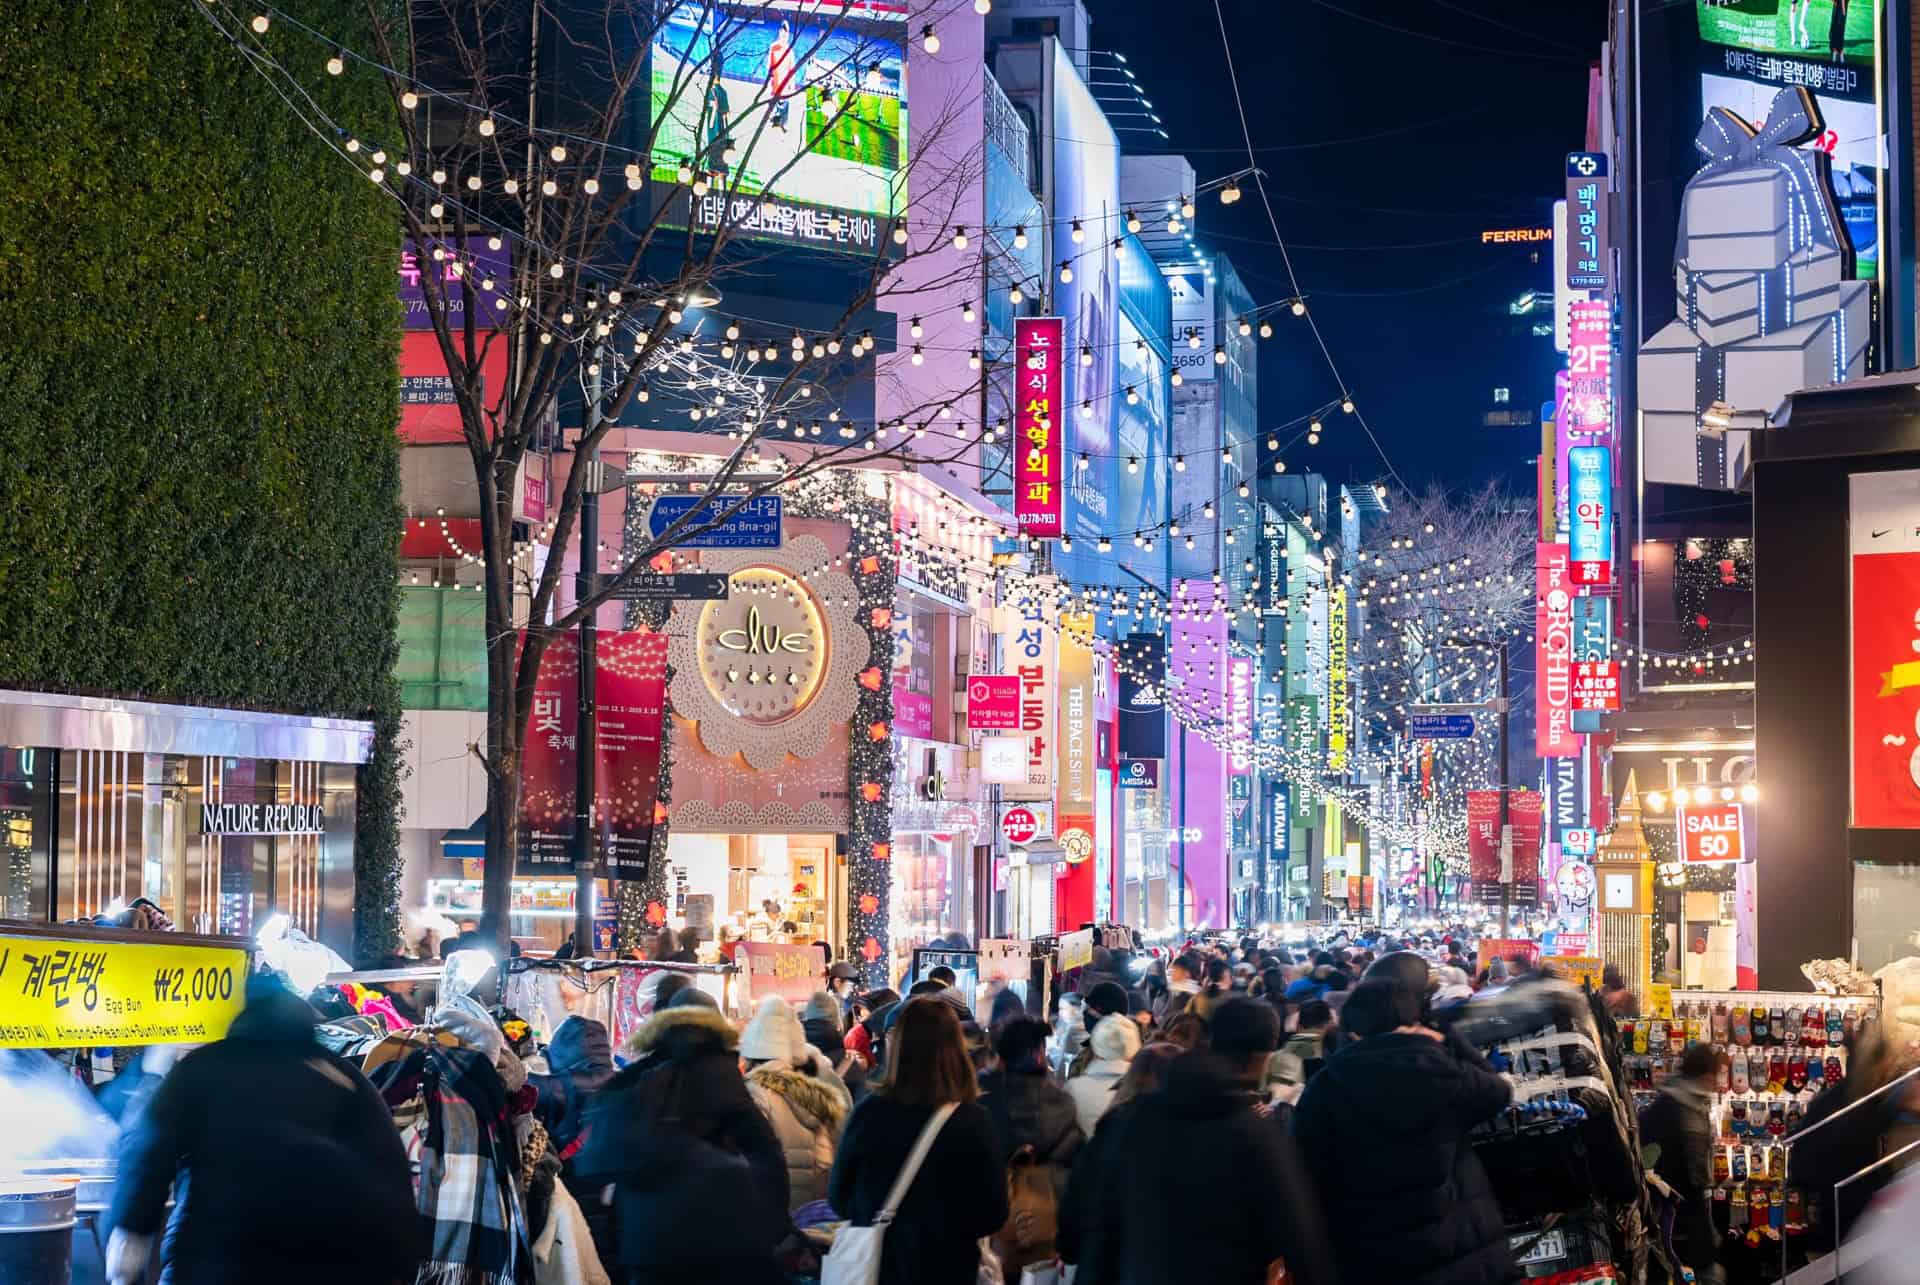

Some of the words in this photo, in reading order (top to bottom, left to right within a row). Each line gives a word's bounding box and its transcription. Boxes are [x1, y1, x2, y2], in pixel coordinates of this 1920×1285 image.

[1482, 228, 1552, 243] FERRUM
[1571, 344, 1608, 373] 2F
[718, 605, 811, 655] clue
[534, 698, 562, 732] 빛
[1069, 686, 1083, 718] THE
[1131, 697, 1161, 705] adidas
[1332, 679, 1344, 737] MART
[548, 734, 576, 750] 축제
[1069, 719, 1083, 759] FACE
[1550, 709, 1567, 745] Skin
[1121, 776, 1154, 786] MISSHA
[203, 802, 259, 833] NATURE
[265, 804, 325, 833] REPUBLIC
[1274, 792, 1286, 850] ARITAUM
[1687, 813, 1738, 833] SALE
[1699, 833, 1729, 857] 50
[22, 949, 108, 1011] 계란빵
[153, 966, 233, 1007] ₩2,000
[105, 998, 124, 1014] Egg
[125, 998, 143, 1012] Bun
